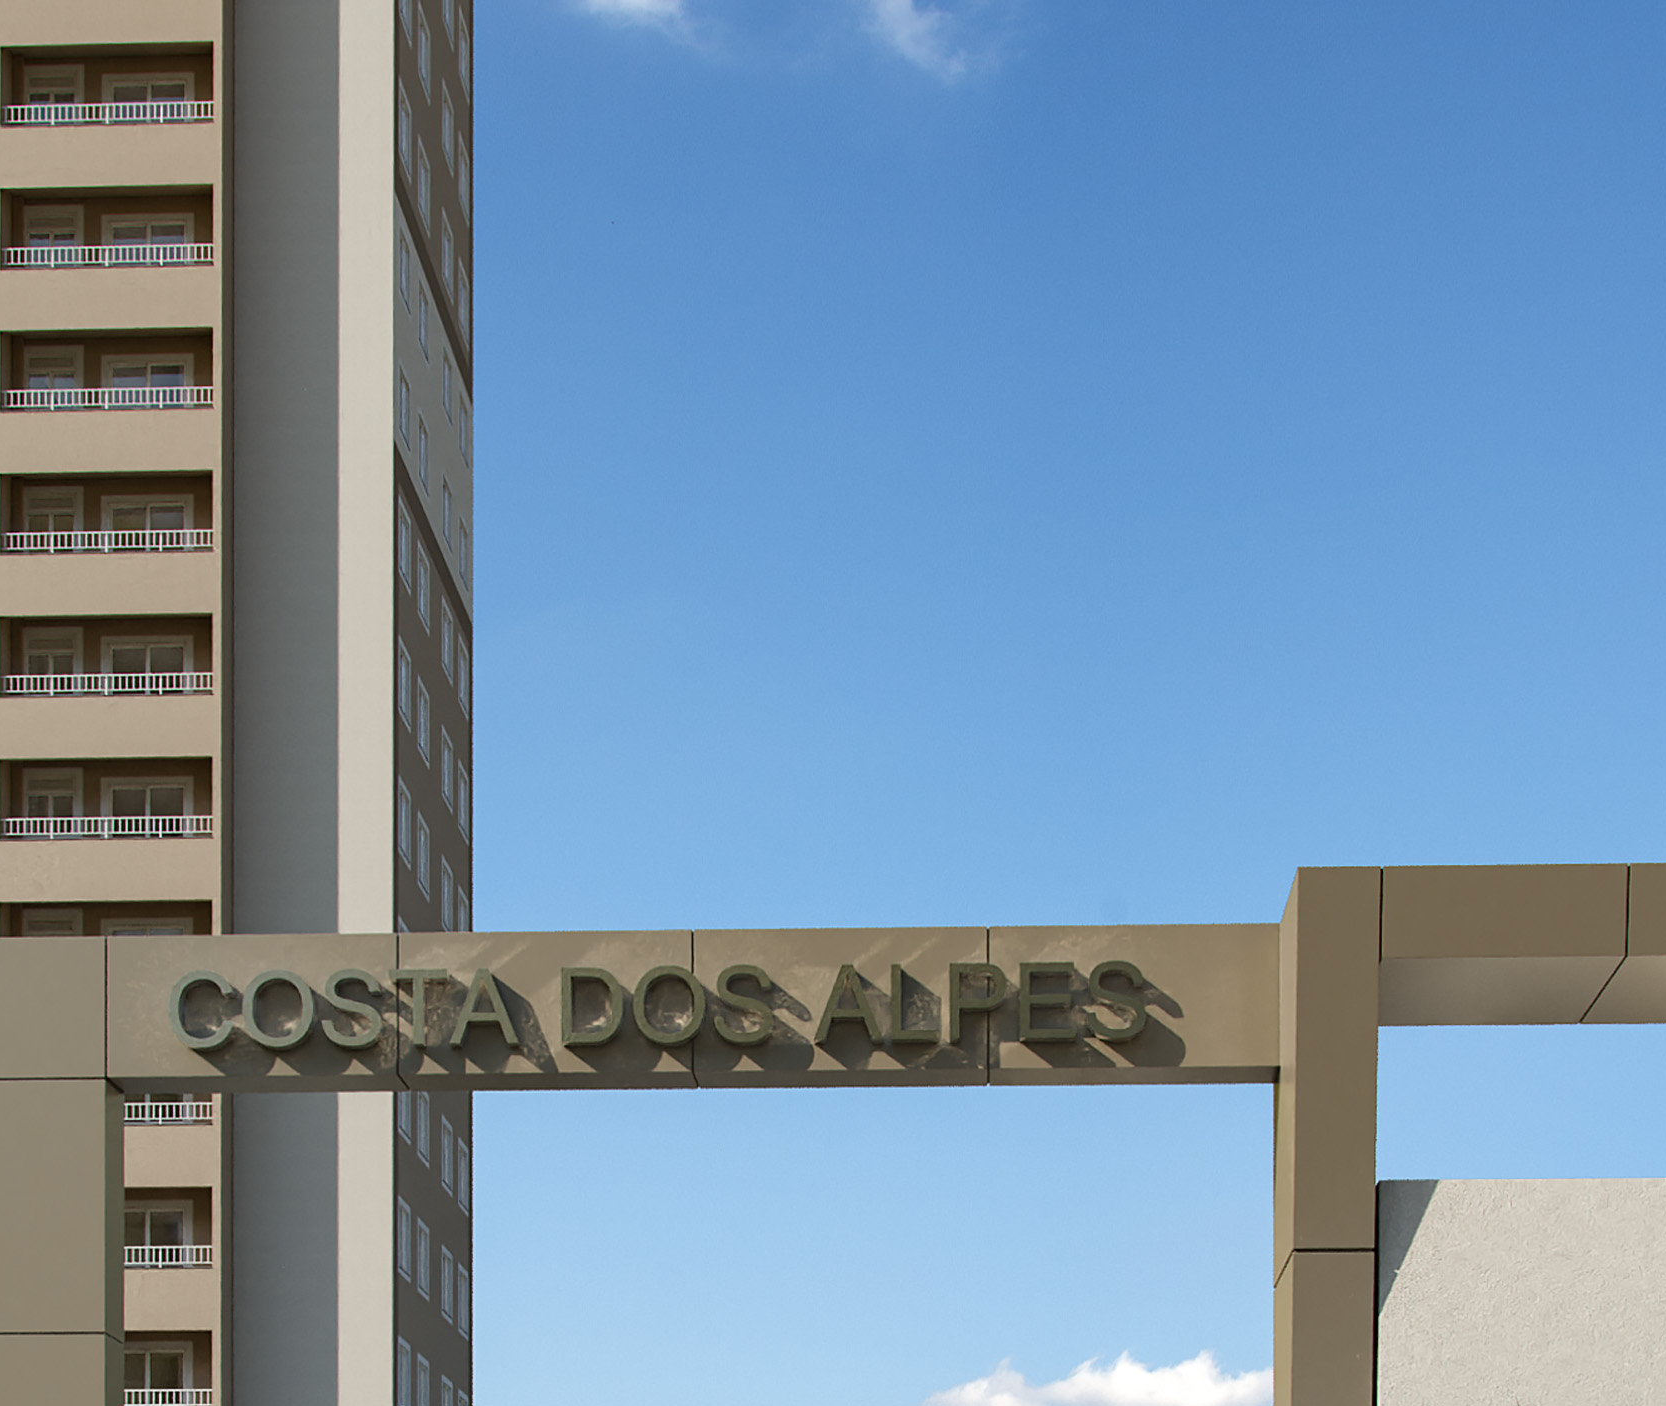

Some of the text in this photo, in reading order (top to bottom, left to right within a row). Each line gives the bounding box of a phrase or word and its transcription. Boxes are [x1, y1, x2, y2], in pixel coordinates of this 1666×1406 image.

[168, 960, 1148, 1048] COSTA DOS ALPES
